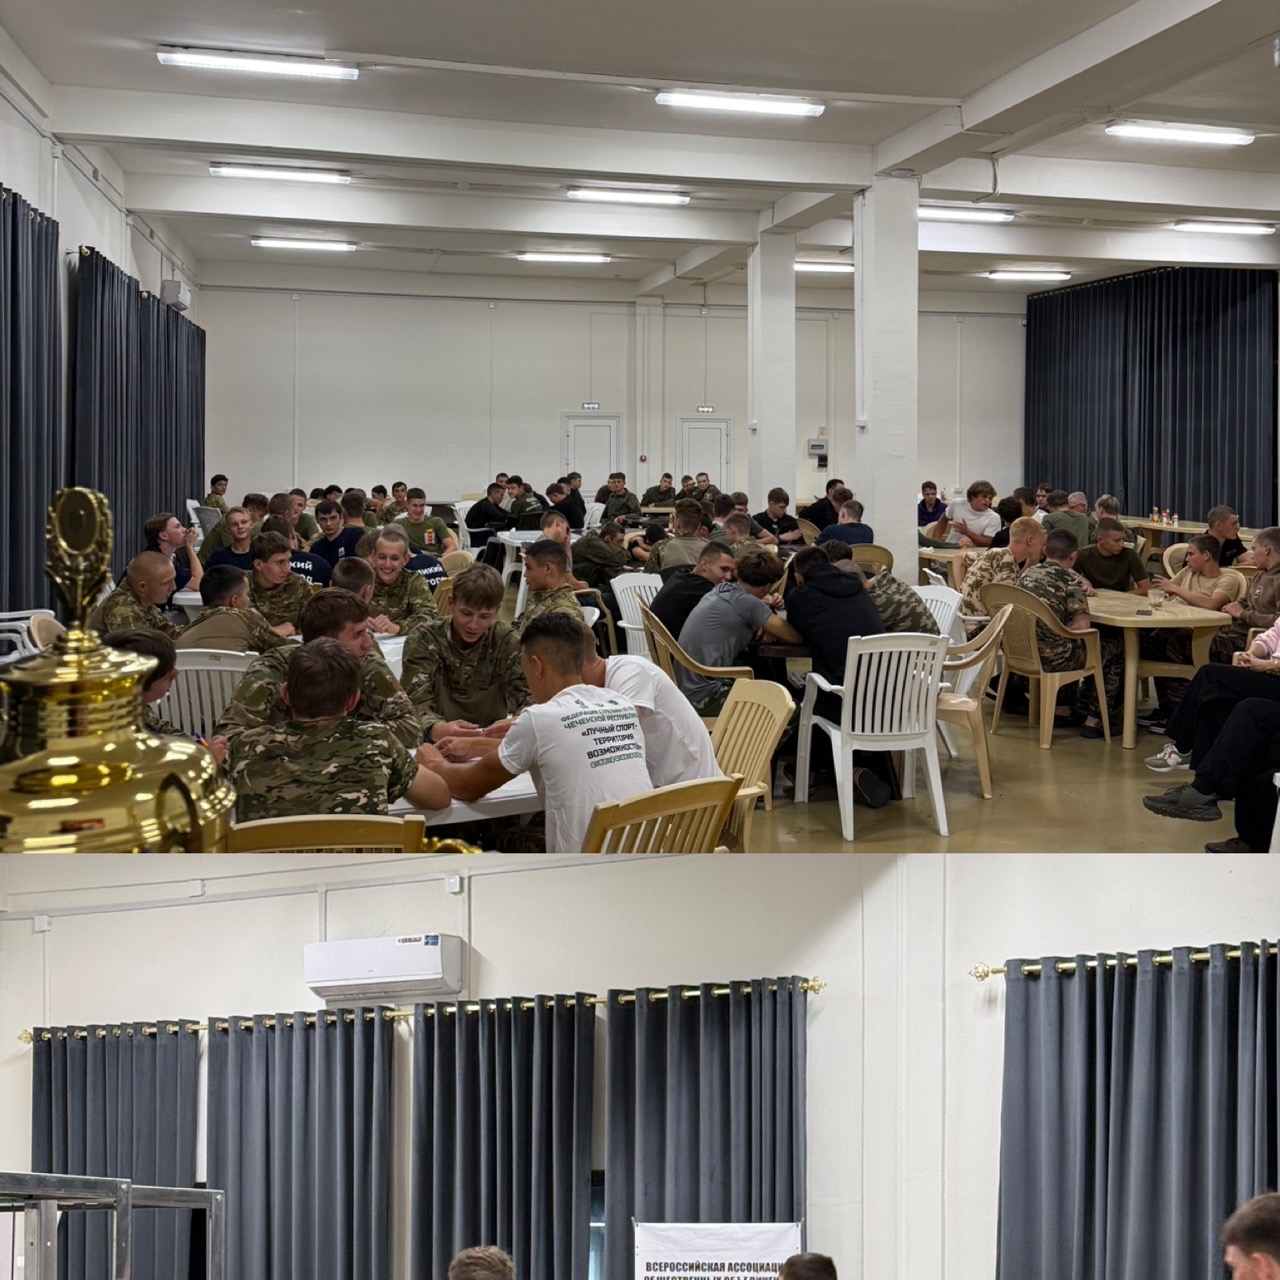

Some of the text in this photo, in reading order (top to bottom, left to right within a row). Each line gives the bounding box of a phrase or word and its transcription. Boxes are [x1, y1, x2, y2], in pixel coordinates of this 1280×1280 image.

[564, 715, 606, 729] ЧЕЧЕНСКОЙ
[593, 733, 635, 745] ТЕРРИТОРИЯ
[646, 1261, 726, 1272] ВСЕРОССИЙСКАЯ
